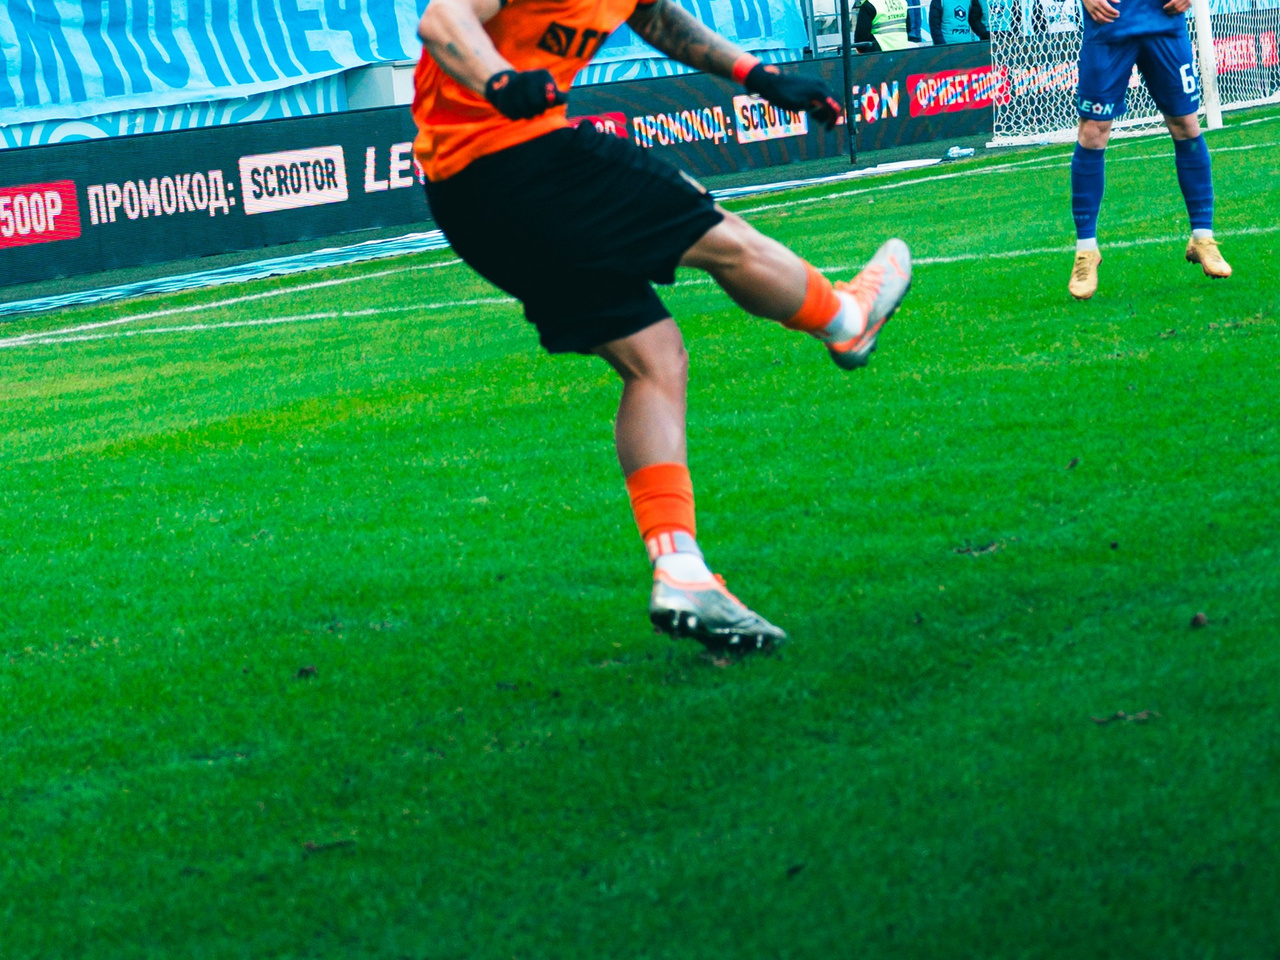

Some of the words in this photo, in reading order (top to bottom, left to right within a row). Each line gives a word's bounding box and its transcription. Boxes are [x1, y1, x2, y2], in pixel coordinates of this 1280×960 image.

[633, 106, 733, 148] ПРОМОКОД:
[837, 80, 900, 124] EON
[916, 74, 970, 109] ФРИБЕТ
[87, 169, 236, 226] ПРОМОКОД:
[250, 158, 340, 200] SCROTOR
[364, 142, 424, 193] LE
